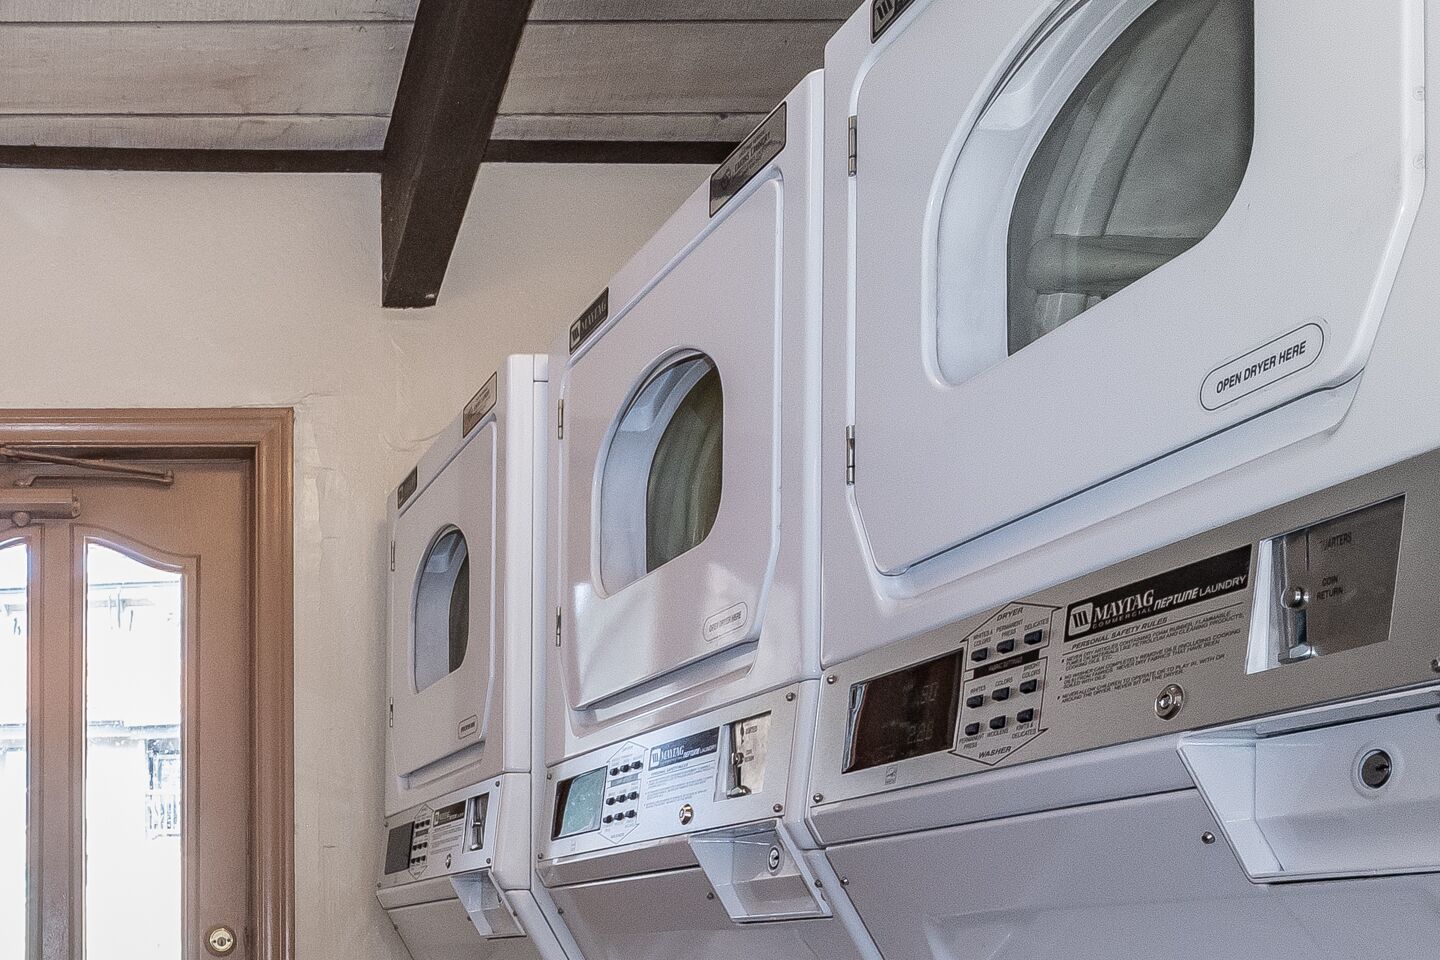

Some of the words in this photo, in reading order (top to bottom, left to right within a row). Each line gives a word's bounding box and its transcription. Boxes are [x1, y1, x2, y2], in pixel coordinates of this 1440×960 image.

[1216, 371, 1242, 394] OPEN
[1243, 355, 1277, 381] DRYER
[1278, 340, 1307, 365] HERE
[1093, 589, 1155, 622] MAYTAG
[1153, 587, 1199, 611] NEPTUNE
[1199, 574, 1247, 596] LAUNDRY
[997, 607, 1024, 622] DRYER
[1092, 608, 1152, 630] COMMERCIAL
[996, 619, 1024, 633] PERMANENT
[1024, 617, 1050, 631] DELICATES
[1072, 635, 1109, 650] PERSONAL
[1111, 625, 1141, 638] SAFETY
[1142, 617, 1168, 630] RULES
[973, 636, 992, 647] COLORS
[1022, 669, 1041, 679] COLORS
[995, 677, 1013, 687] COLORS
[1011, 729, 1037, 739] DELICATES
[979, 746, 1012, 759] WASHER
